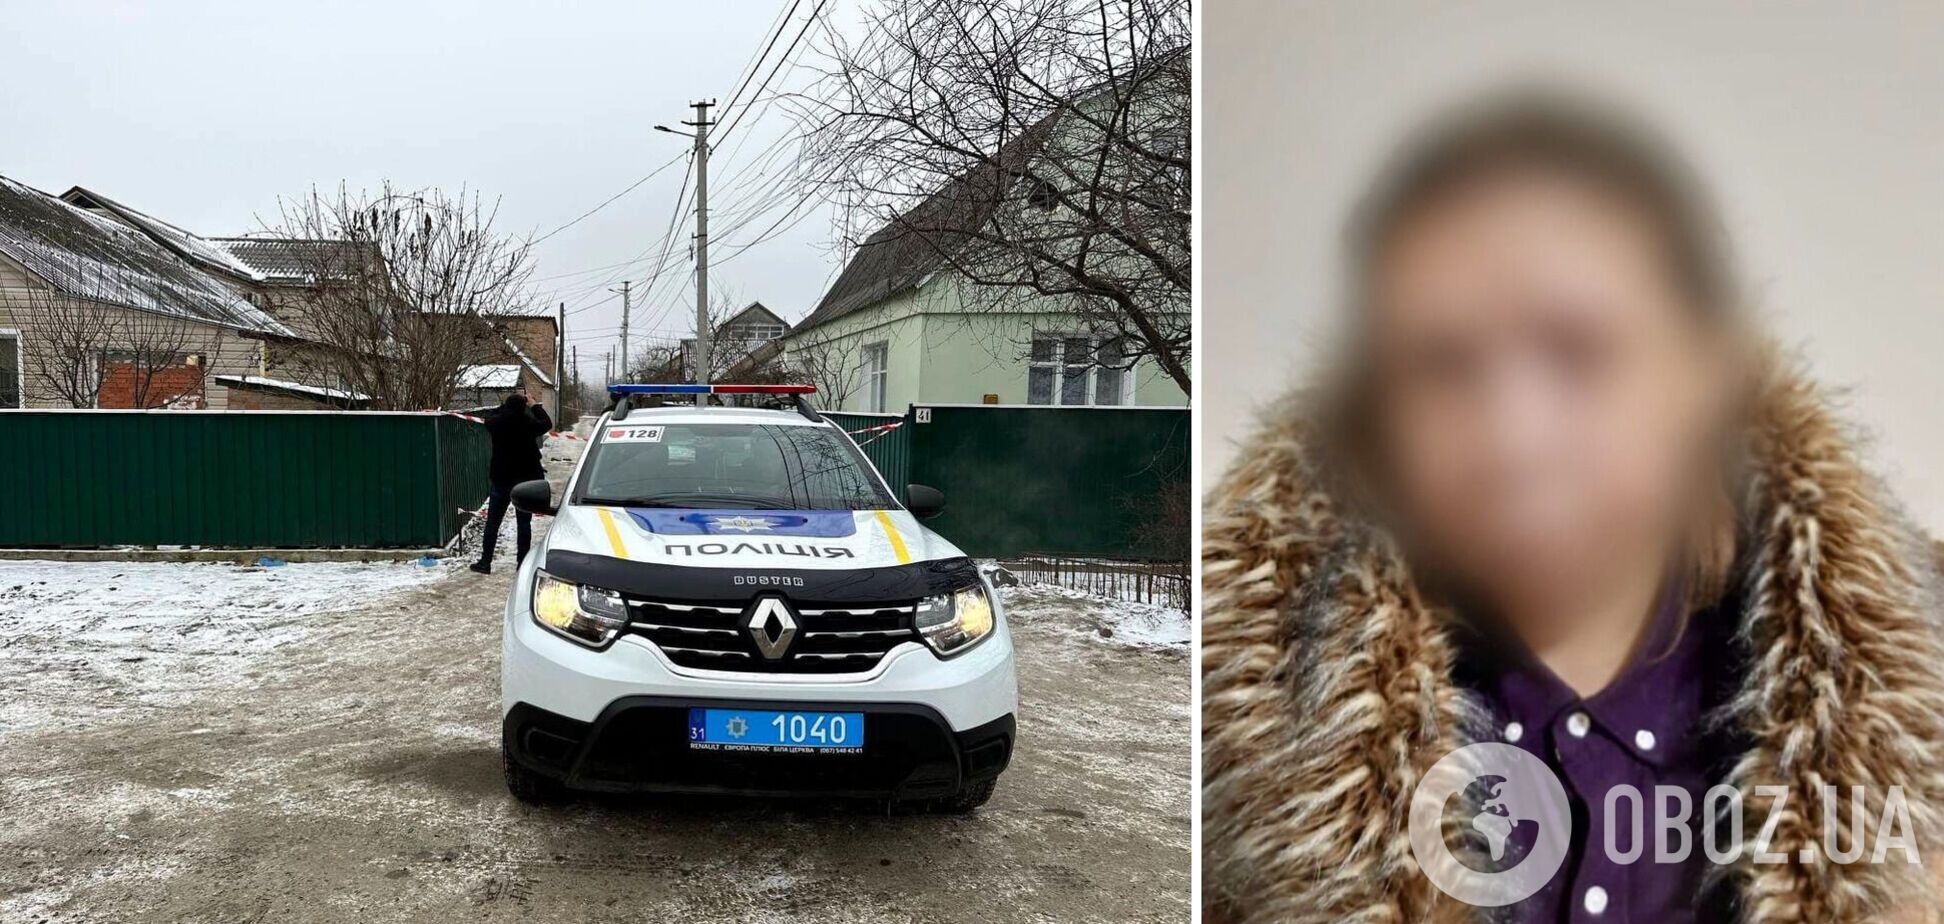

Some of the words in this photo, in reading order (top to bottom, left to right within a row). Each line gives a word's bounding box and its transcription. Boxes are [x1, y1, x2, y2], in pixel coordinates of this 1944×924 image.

[918, 410, 930, 421] 41
[628, 429, 658, 438] 128
[664, 543, 856, 559] ПОЛІЦІЯ
[733, 575, 804, 587] DUSTER
[690, 727, 705, 740] 31
[771, 714, 846, 744] 1040
